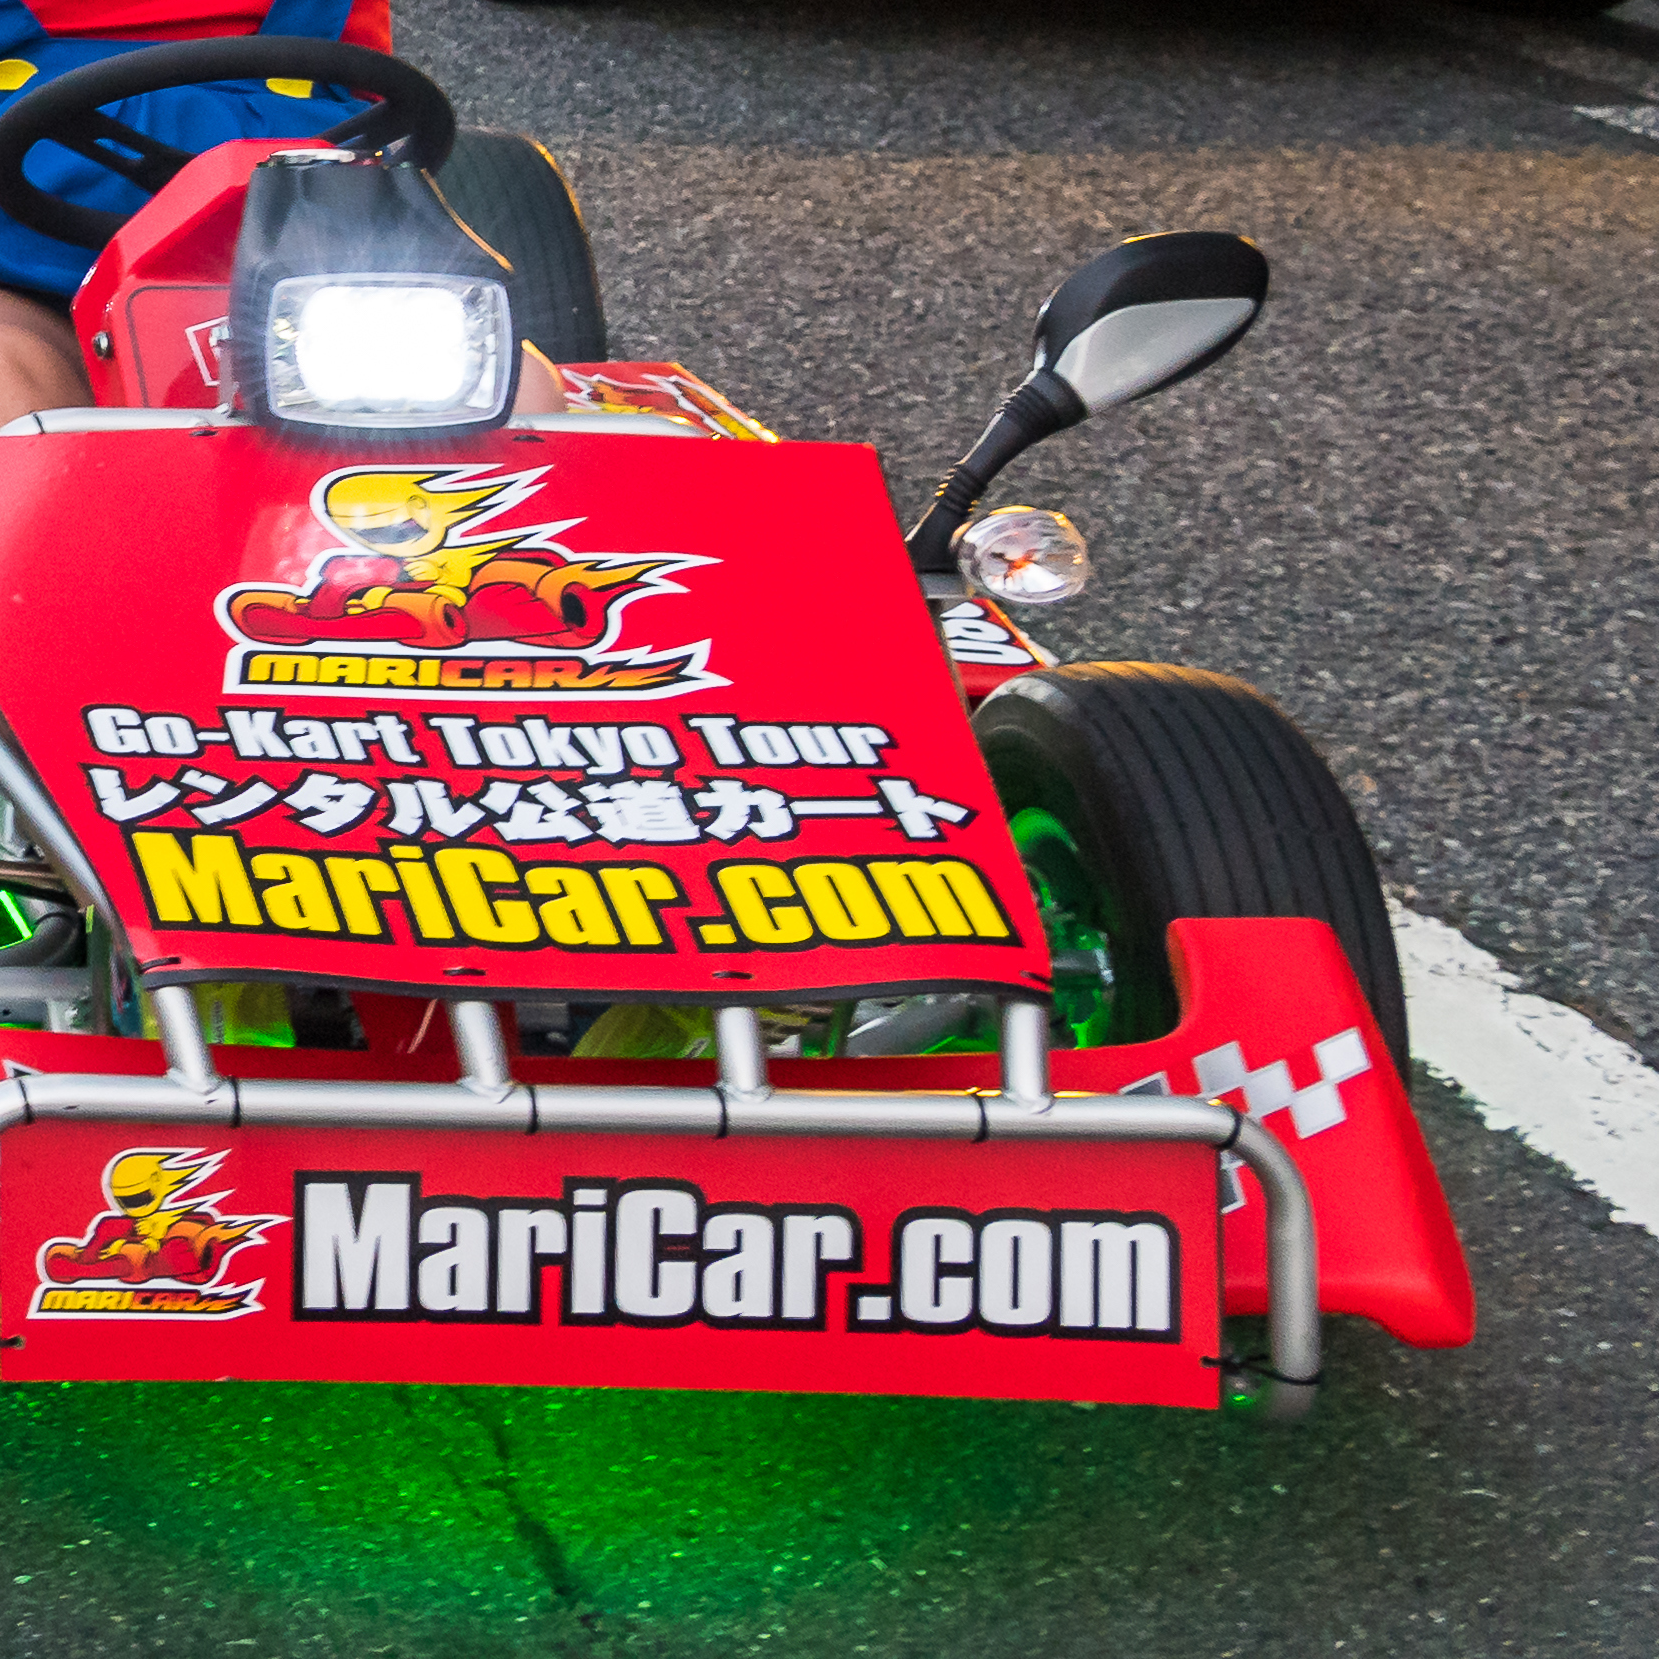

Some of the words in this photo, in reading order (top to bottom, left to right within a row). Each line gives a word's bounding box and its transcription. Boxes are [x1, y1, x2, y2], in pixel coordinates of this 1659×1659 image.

[247, 652, 606, 688] MARICAR
[85, 706, 419, 766] Go-Kart
[430, 714, 681, 774] Tokyo
[690, 715, 891, 768] Tour
[90, 764, 969, 844] レンタル公道カート
[131, 830, 1013, 950] MariCar.com
[302, 1181, 1171, 1332] MariCar.com
[41, 1290, 211, 1310] MARICAR
